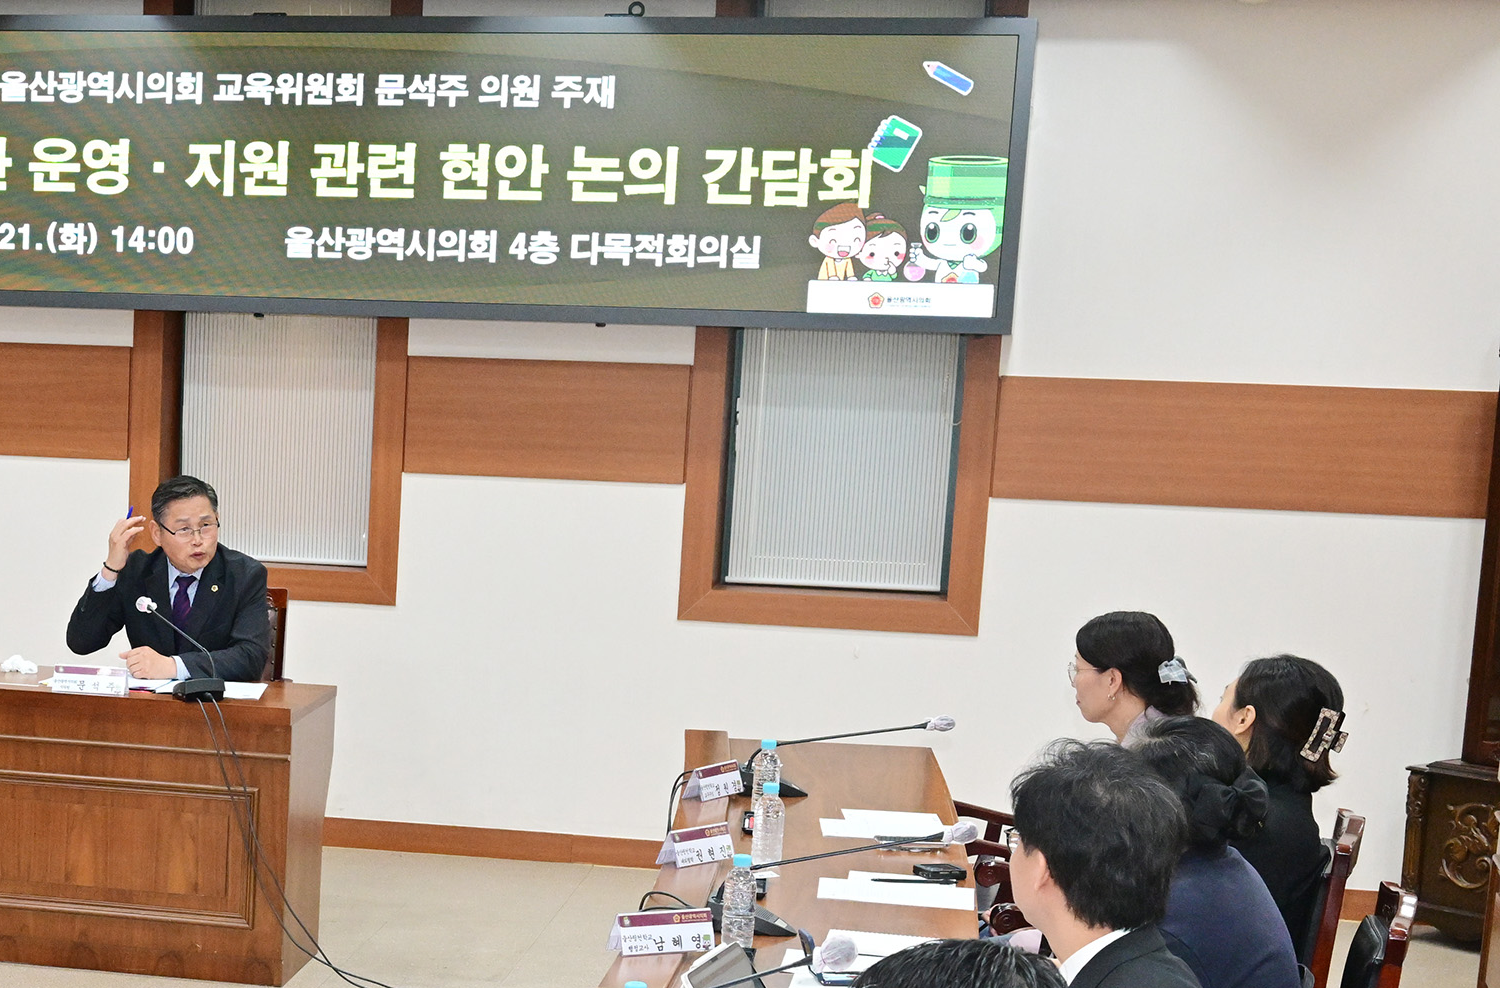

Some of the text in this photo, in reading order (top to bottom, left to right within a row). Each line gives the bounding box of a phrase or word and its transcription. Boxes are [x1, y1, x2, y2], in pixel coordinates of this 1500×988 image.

[0, 71, 615, 109] 울산광역시의회 교육위원회 문석주 의원 주재
[28, 137, 131, 195] 운영
[185, 139, 289, 197] 지원
[310, 141, 417, 199] 관련
[439, 143, 549, 201] 현안
[566, 145, 680, 205] 논의
[701, 148, 874, 209] 간담회
[112, 226, 194, 254] 14:00
[285, 227, 762, 269] 울산광역시의회 4층 다목적회의실
